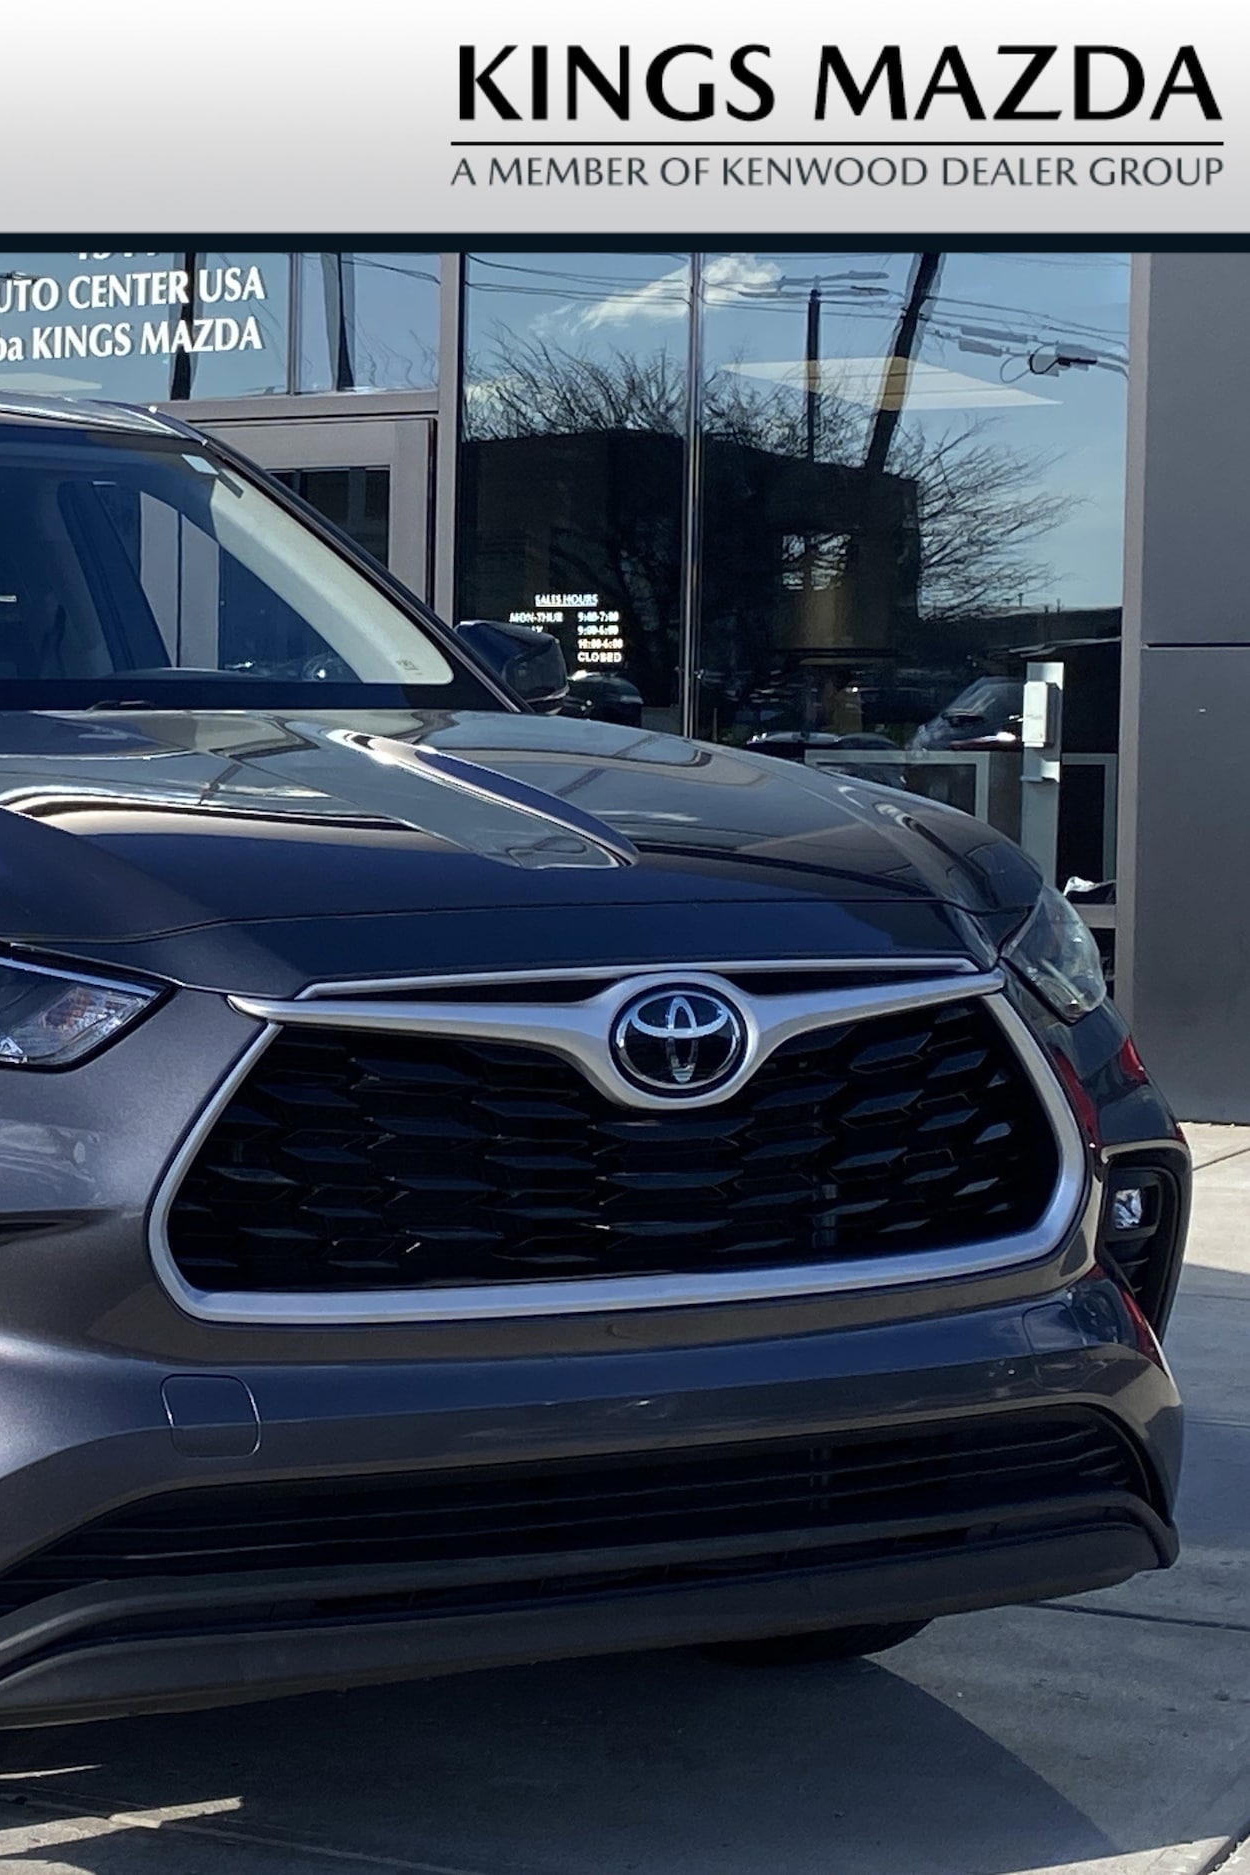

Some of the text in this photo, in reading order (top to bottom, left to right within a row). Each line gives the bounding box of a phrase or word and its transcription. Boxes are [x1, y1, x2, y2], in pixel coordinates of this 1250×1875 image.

[68, 270, 189, 310] CENTER
[199, 265, 265, 303] USA
[32, 322, 132, 360] KINGS
[140, 315, 263, 355] MAZDA
[535, 593, 598, 606] SALES HOURS
[577, 652, 622, 662] CLOSED
